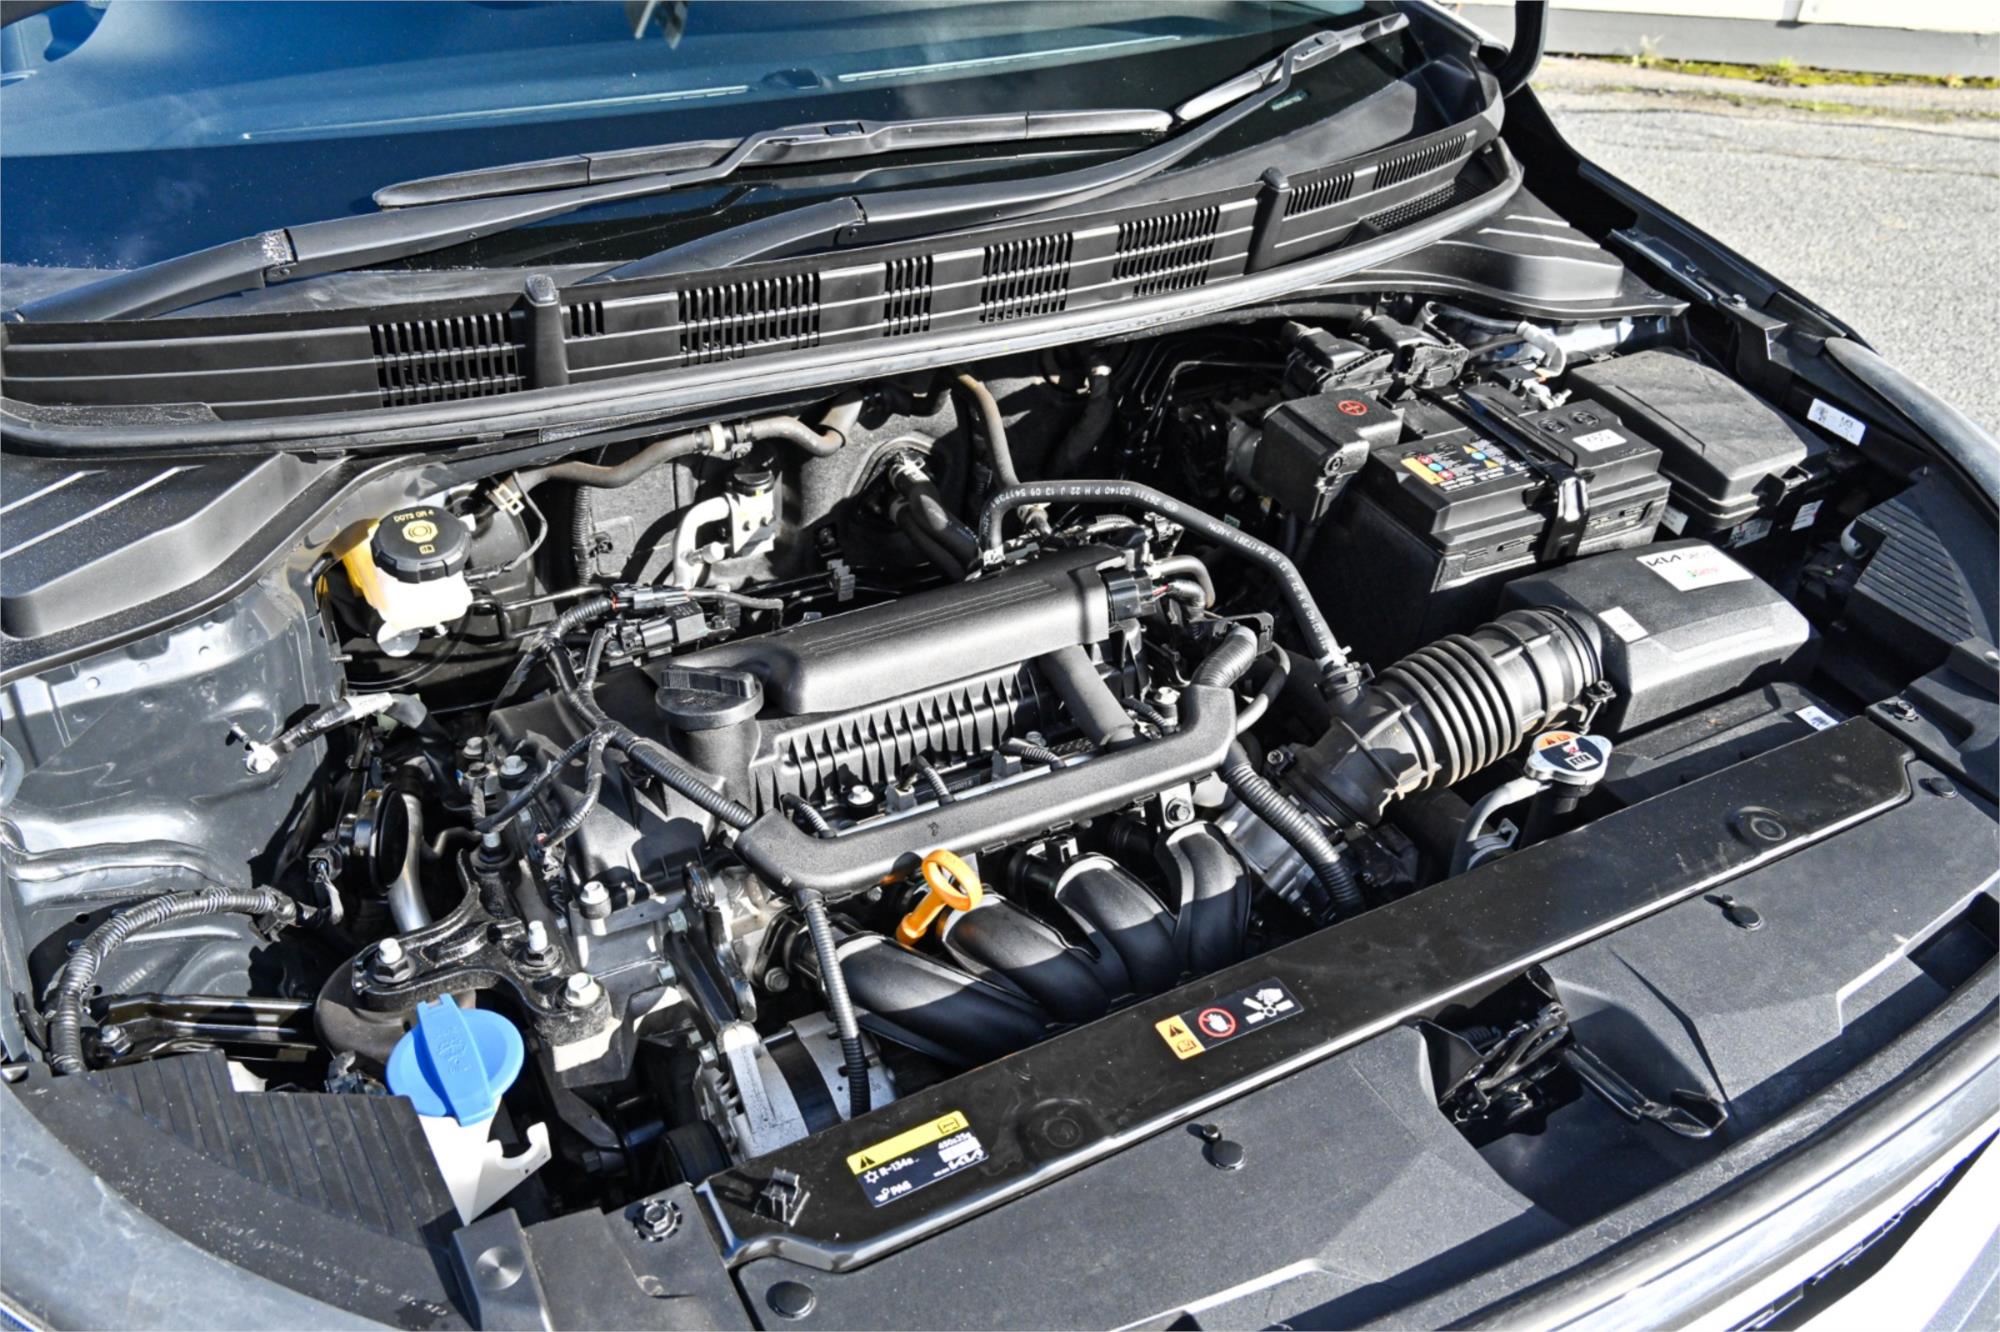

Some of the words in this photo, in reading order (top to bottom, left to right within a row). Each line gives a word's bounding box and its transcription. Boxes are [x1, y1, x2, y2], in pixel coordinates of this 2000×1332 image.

[1070, 485, 1081, 496] 22
[1104, 486, 1131, 496] 03140
[1646, 554, 1681, 567] KIA
